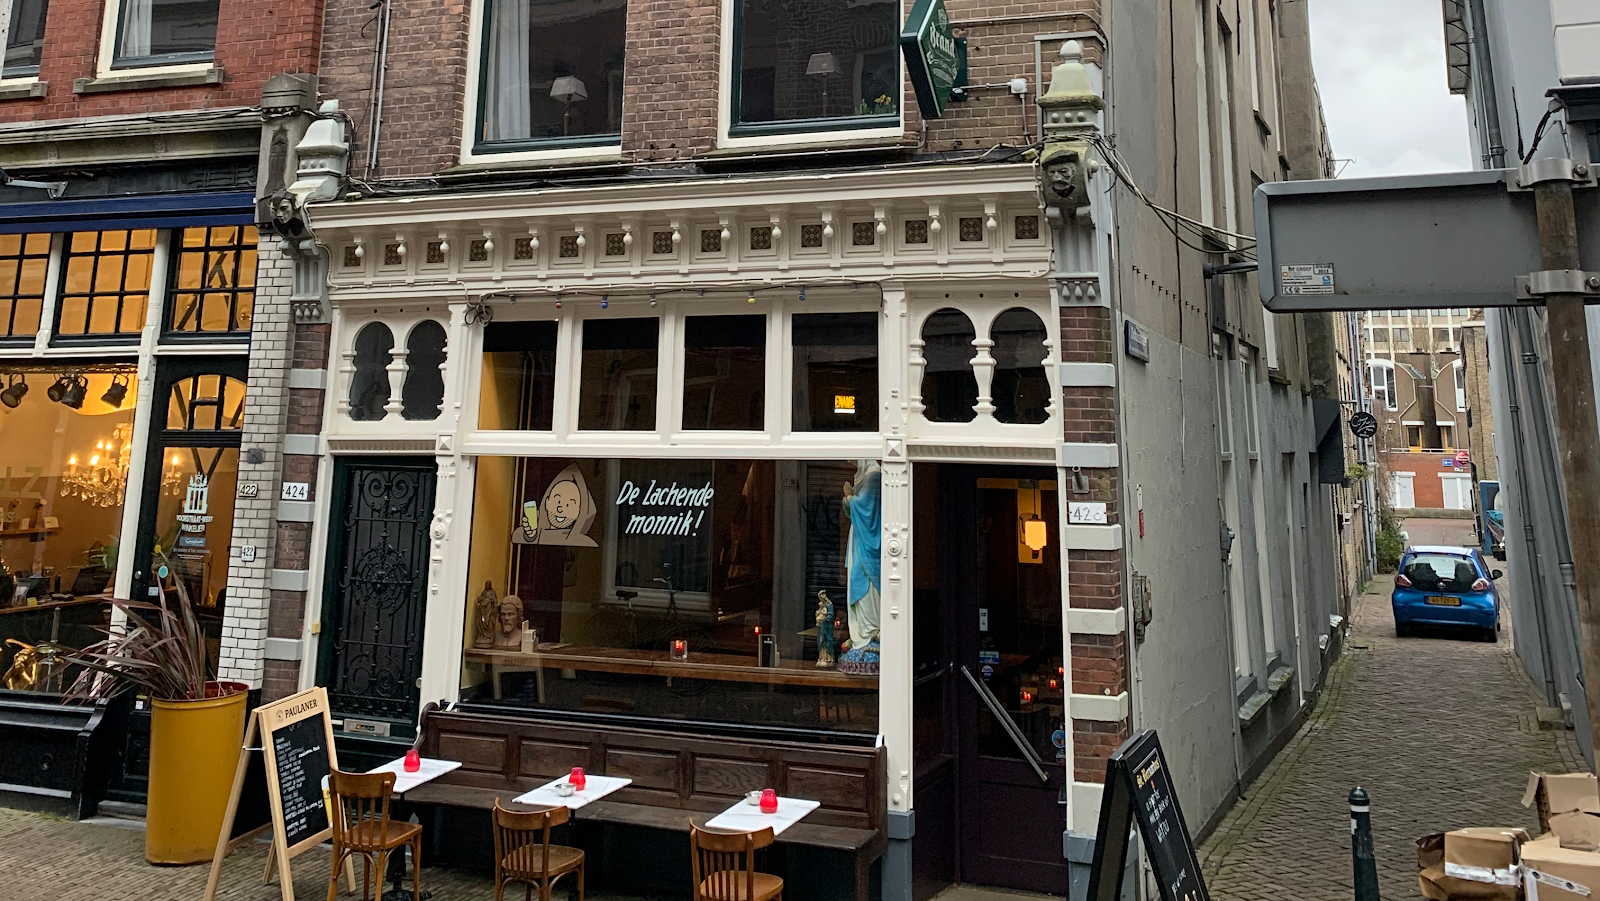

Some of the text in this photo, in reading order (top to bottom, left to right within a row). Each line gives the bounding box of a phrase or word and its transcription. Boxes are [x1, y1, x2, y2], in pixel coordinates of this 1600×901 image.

[929, 21, 956, 58] Brand
[240, 484, 256, 496] 422
[285, 485, 305, 498] 424
[615, 480, 641, 506] De
[1073, 506, 1102, 521] 426
[625, 510, 704, 537] monnik!
[242, 546, 254, 557] 422
[284, 699, 318, 719] PAULANER
